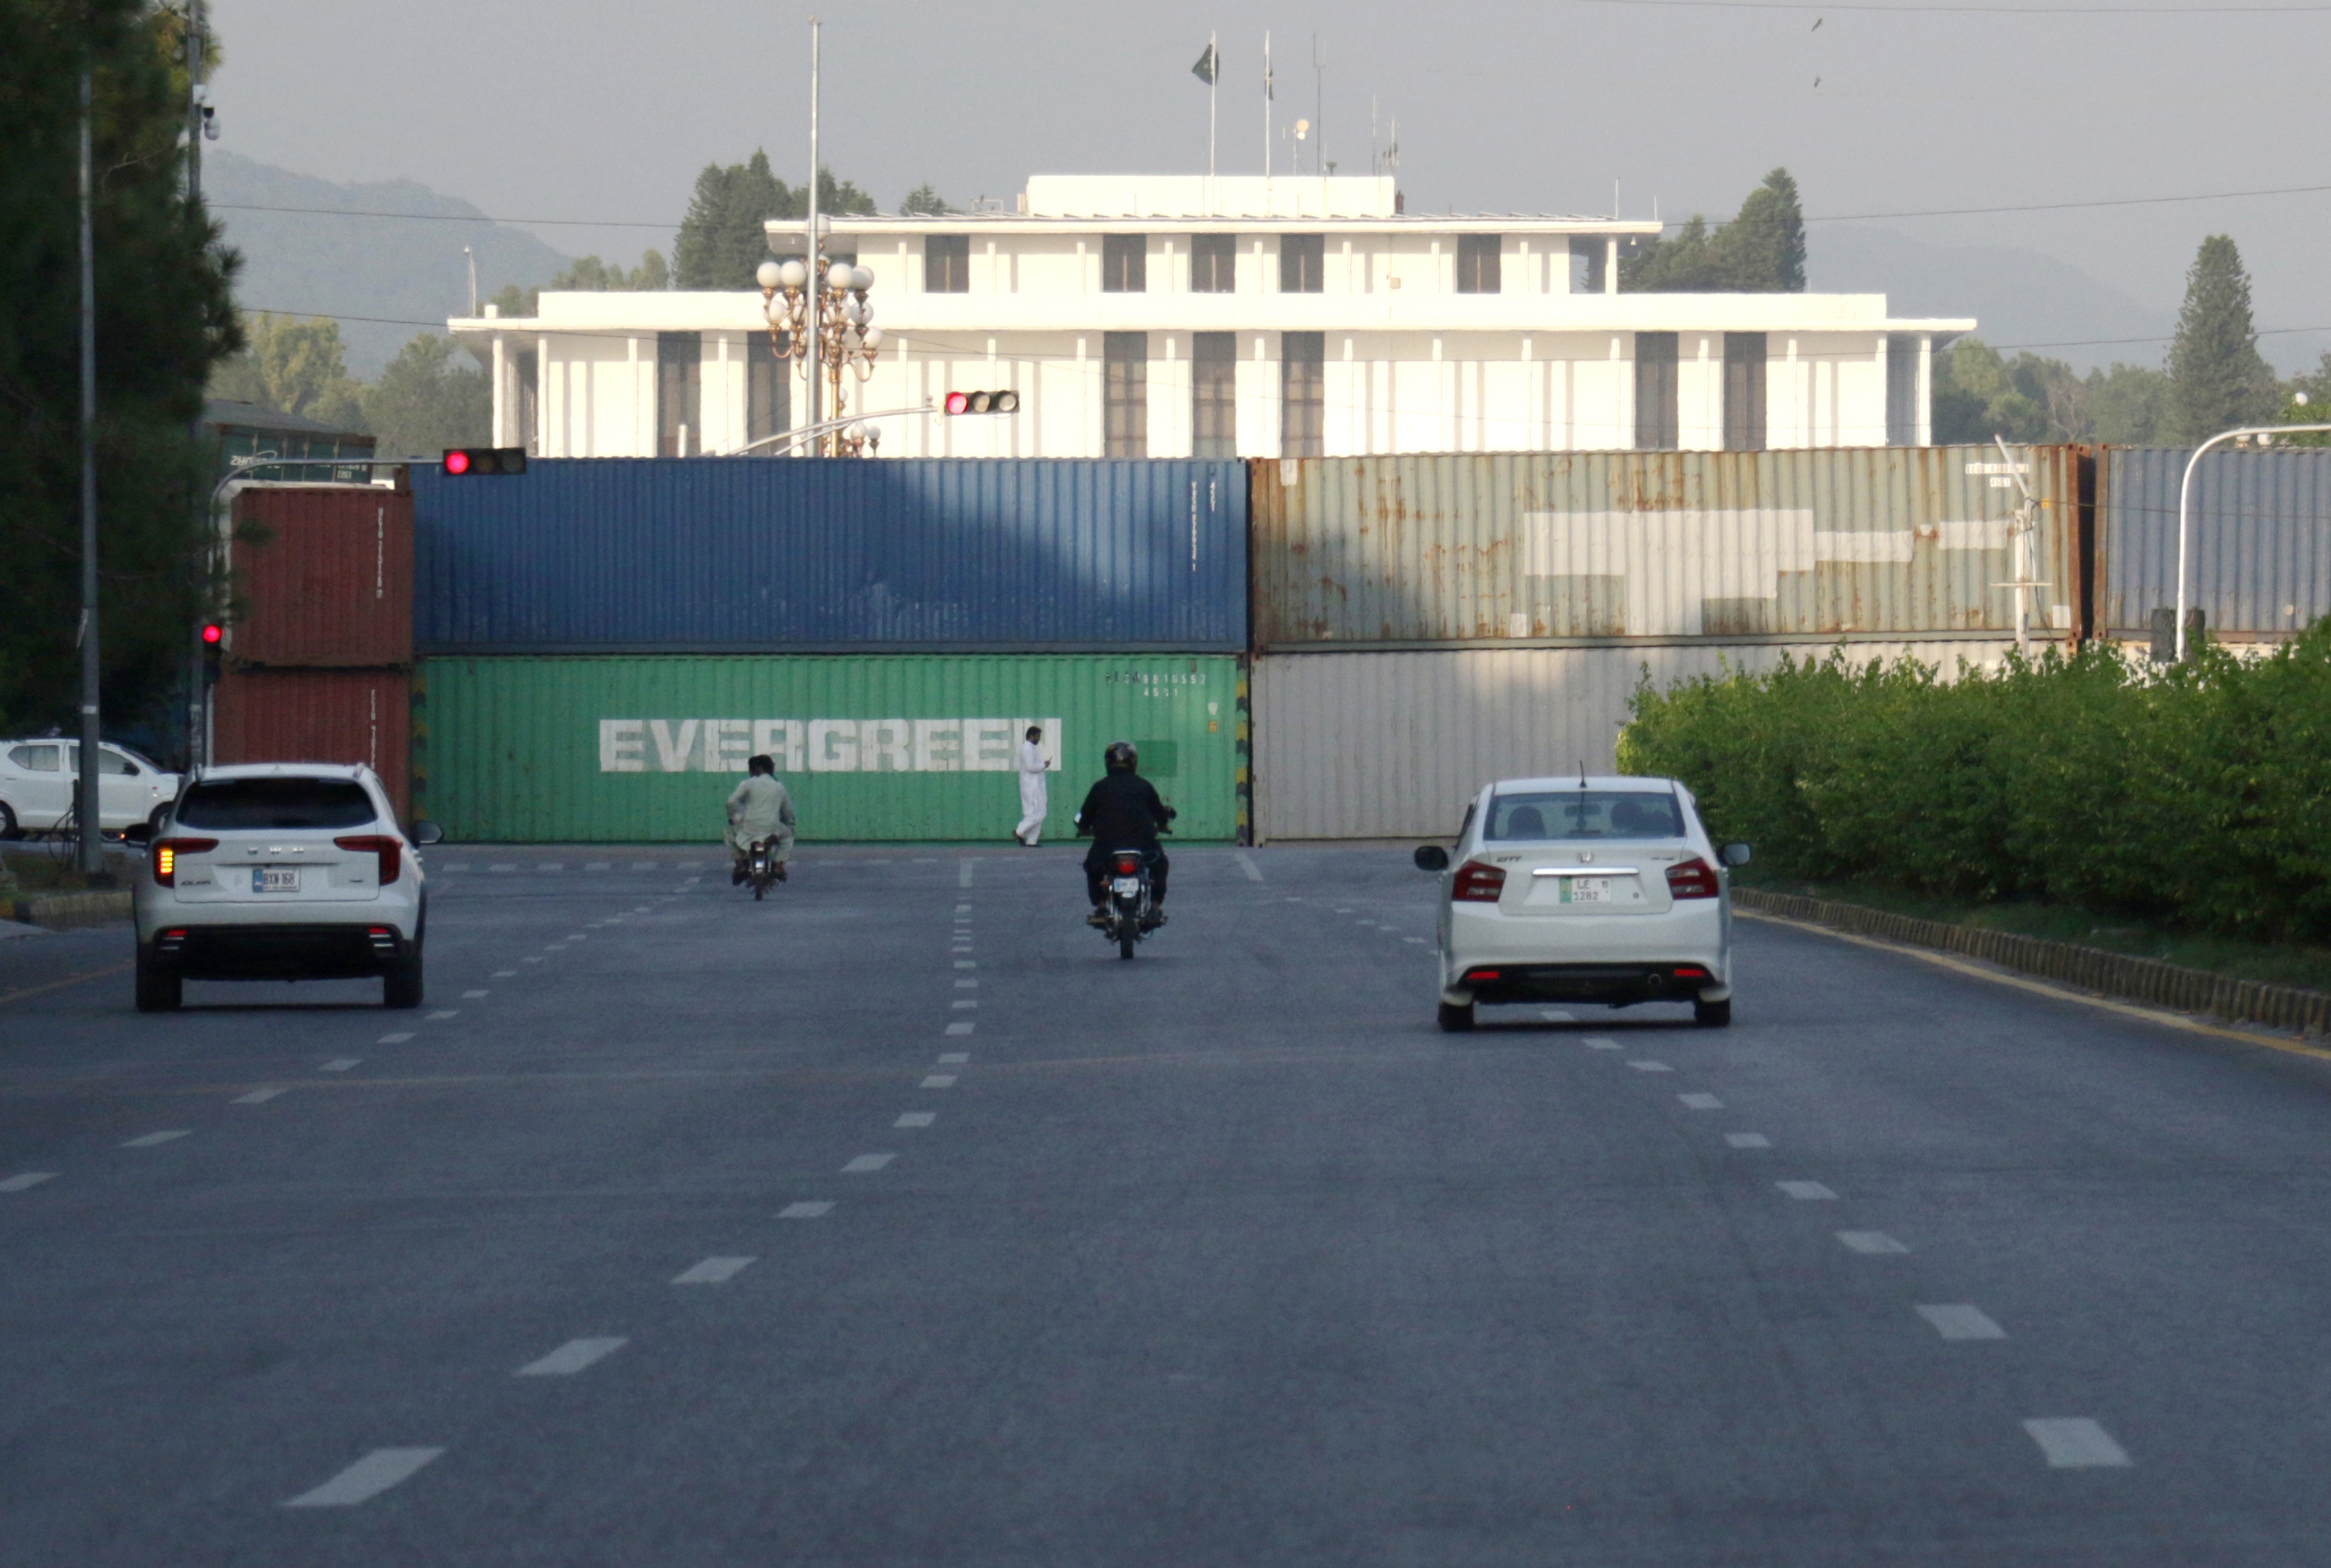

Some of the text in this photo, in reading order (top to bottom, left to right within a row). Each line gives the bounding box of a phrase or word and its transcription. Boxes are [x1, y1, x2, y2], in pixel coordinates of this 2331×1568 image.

[599, 718, 1061, 772] EVERGREEN
[1577, 880, 1590, 890] LE
[1573, 891, 1598, 901] 1282
